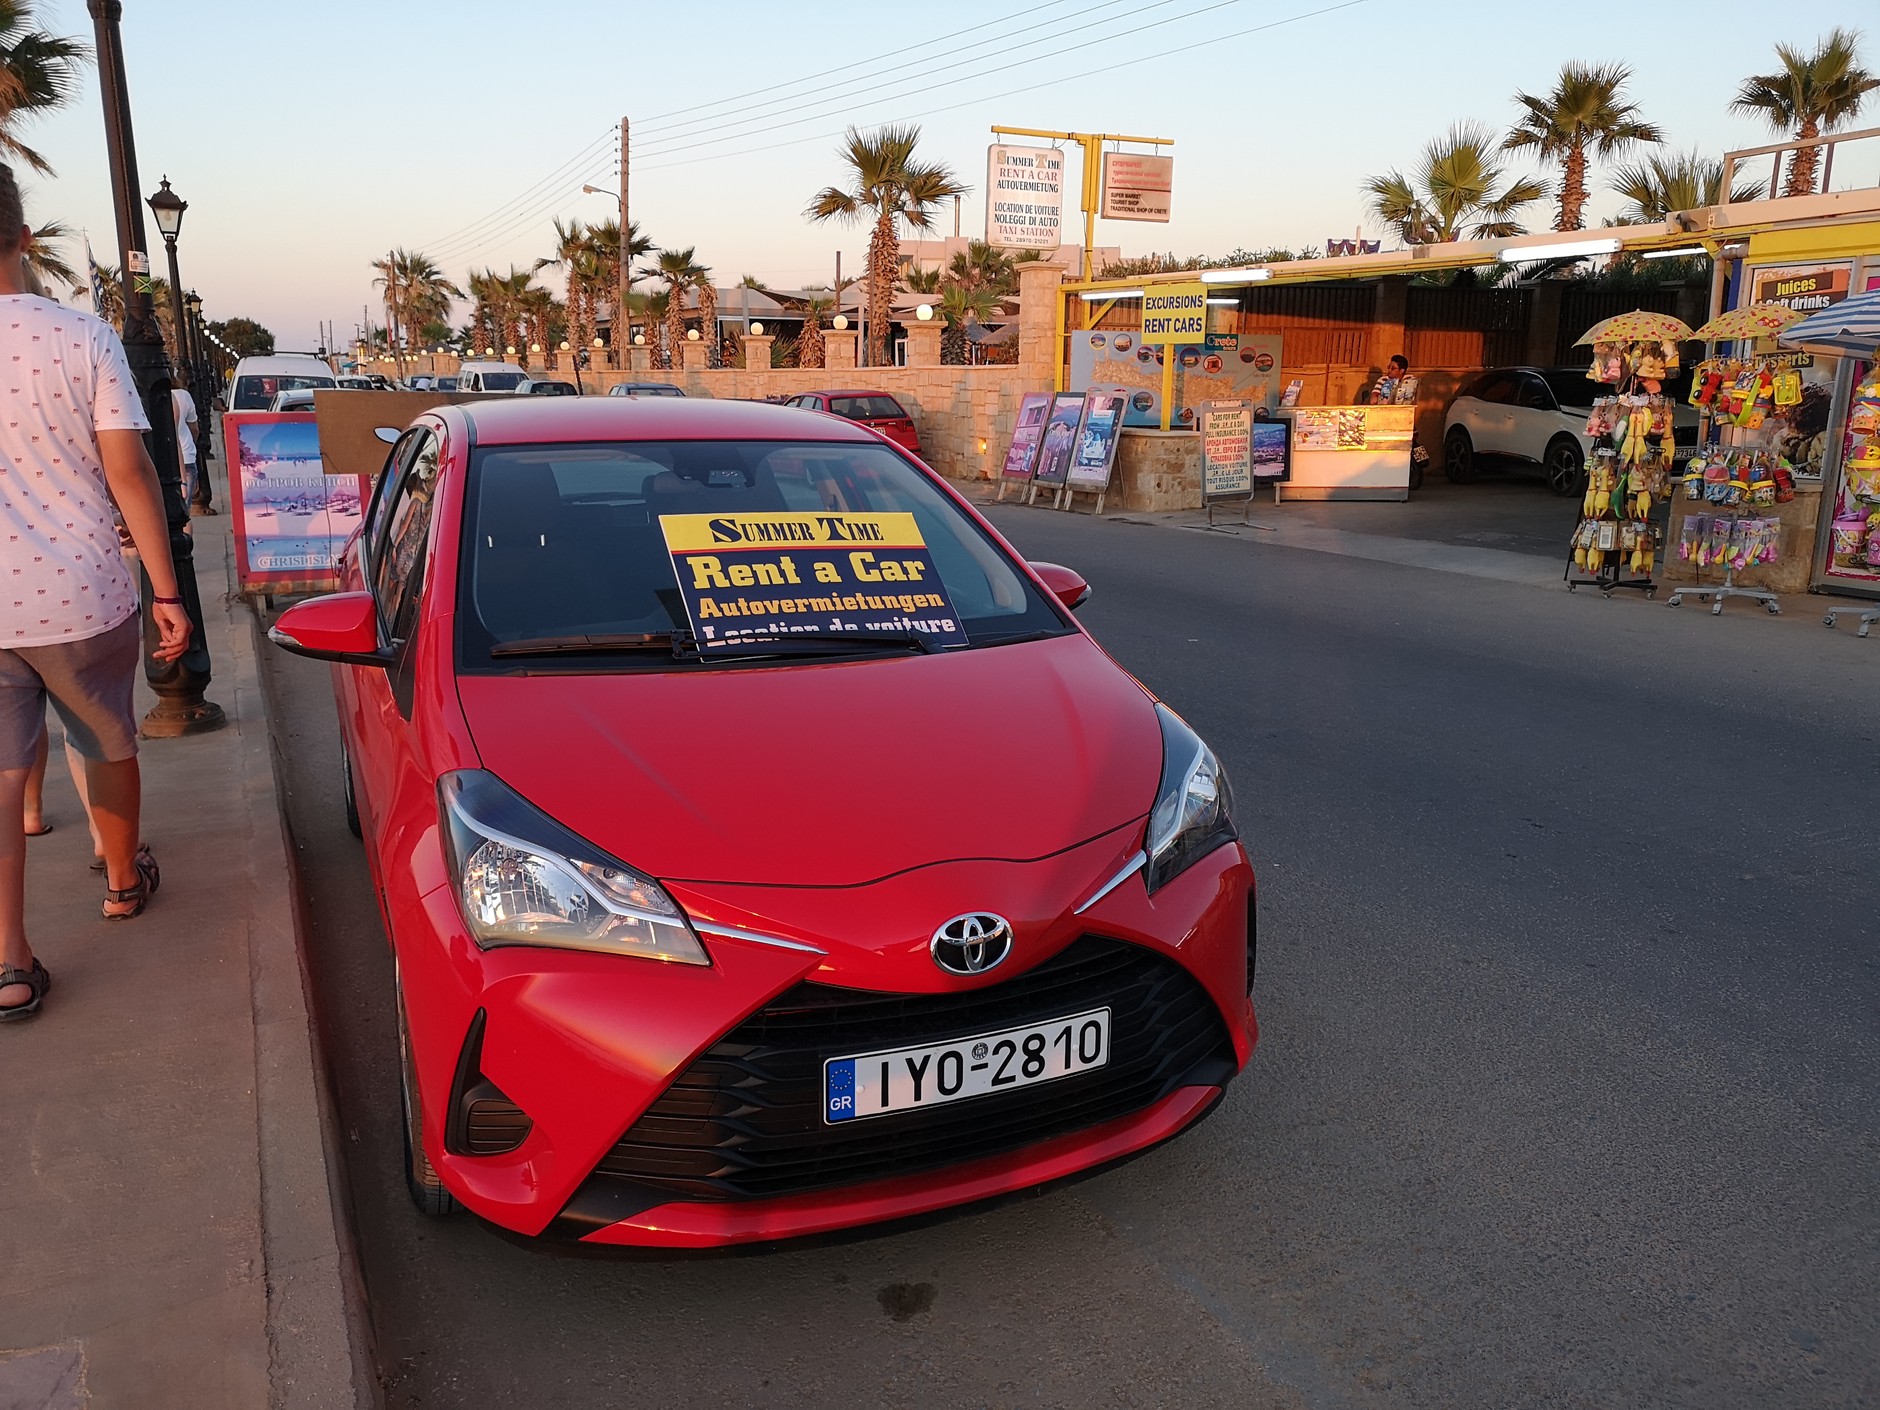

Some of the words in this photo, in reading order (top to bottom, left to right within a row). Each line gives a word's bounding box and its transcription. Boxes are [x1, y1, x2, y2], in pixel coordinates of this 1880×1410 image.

[997, 150, 1033, 167] SUMMER
[1035, 153, 1061, 170] TIME
[1000, 167, 1026, 179] RENT
[1028, 170, 1035, 180] A
[1037, 171, 1058, 182] CAR
[997, 179, 1059, 193] AUTOVERMIETUNG
[994, 202, 1024, 214] LOCATION
[1025, 204, 1033, 215] DE
[1034, 205, 1060, 216] VOITURE
[1110, 205, 1136, 213] TRADITIONAL
[994, 213, 1026, 225] NOLEGGI
[1028, 215, 1037, 226] DI
[1038, 217, 1059, 228] AUTO
[999, 225, 1017, 235] TAXI
[1020, 227, 1054, 237] STATION
[1776, 278, 1816, 297] Juices
[1145, 295, 1203, 310] EXCURSIONS
[1791, 295, 1830, 310] drinks
[1144, 318, 1172, 333] RENT
[1173, 317, 1203, 333] CARS
[1207, 335, 1237, 347] Crete
[1215, 429, 1237, 437] INSURANCE
[245, 477, 303, 489] ОСТРОВ
[1219, 476, 1235, 484] RISQUE
[708, 518, 815, 543] SUMMER
[815, 517, 884, 542] TIME
[686, 555, 801, 590] Rent
[813, 561, 843, 583] a
[848, 551, 926, 583] Car
[699, 591, 945, 619] Autovermietungen
[830, 1096, 852, 1111] GR
